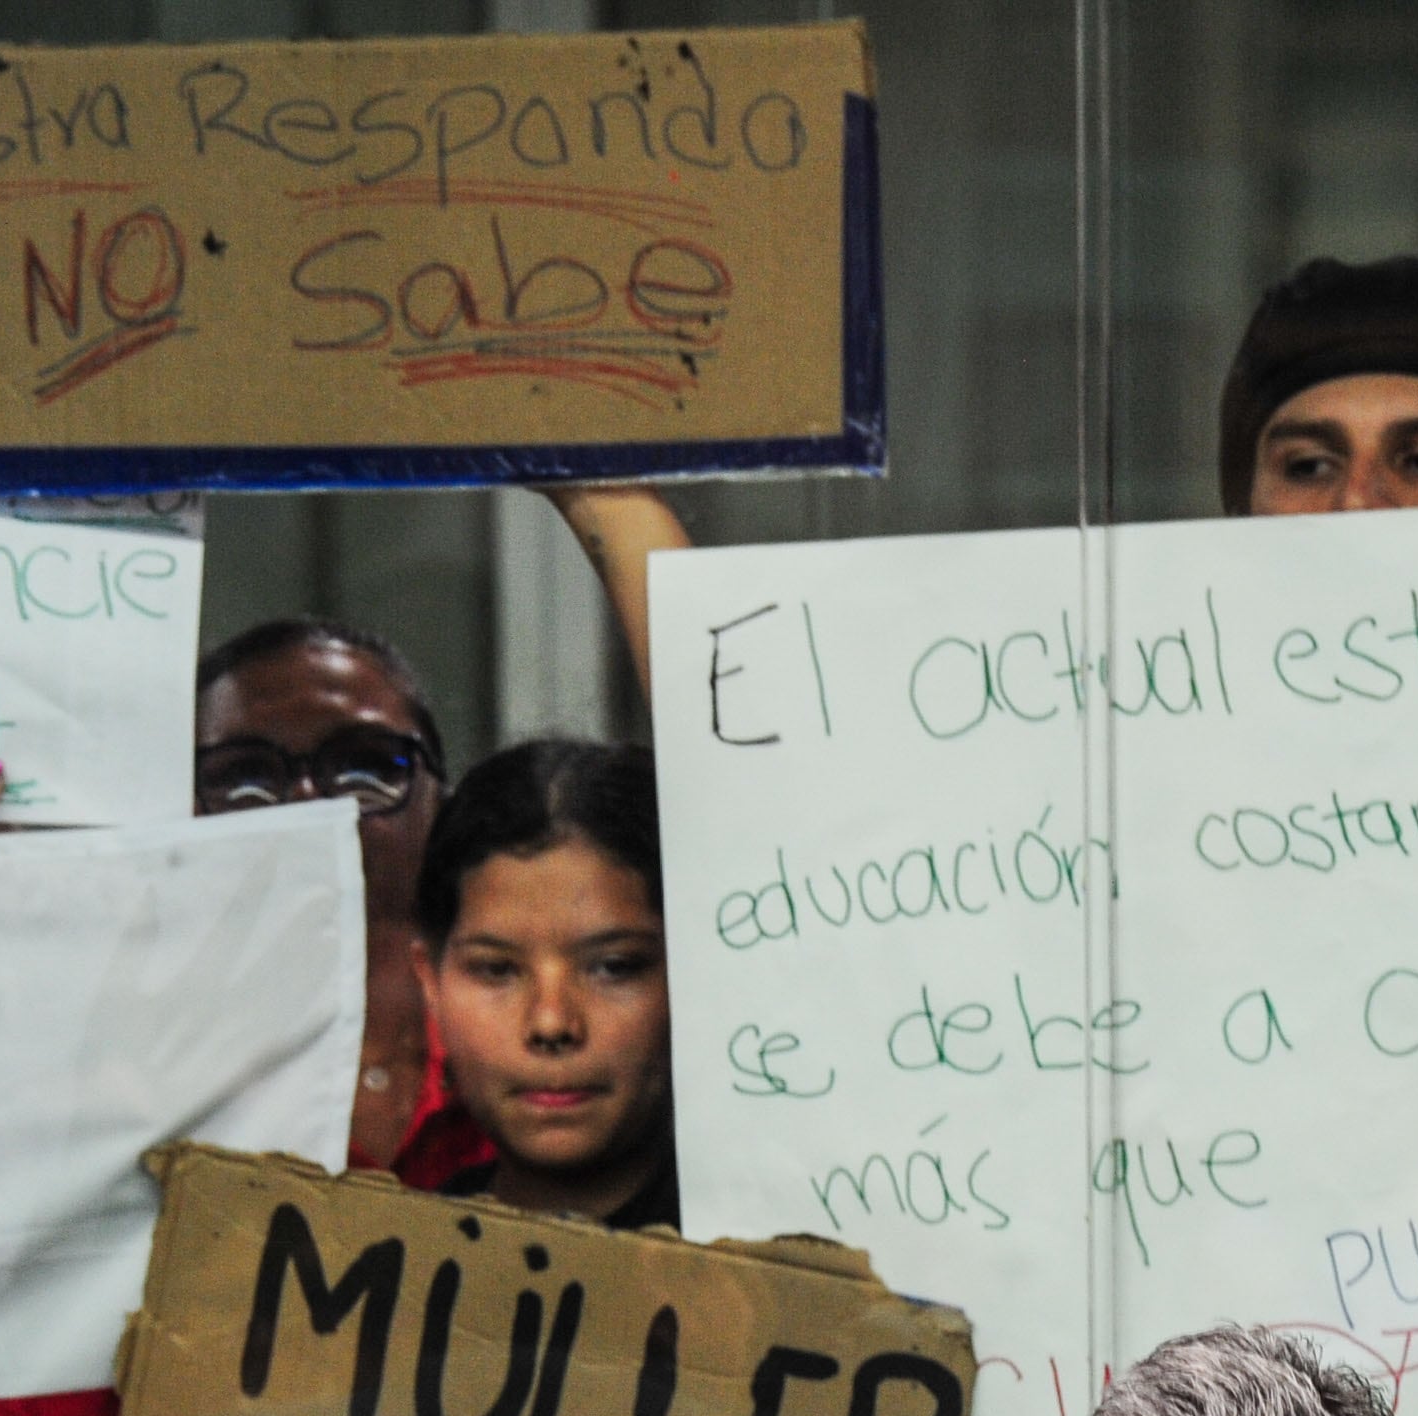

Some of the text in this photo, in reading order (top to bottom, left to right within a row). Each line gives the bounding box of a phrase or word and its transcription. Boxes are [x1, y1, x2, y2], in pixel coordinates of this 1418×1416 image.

[22, 205, 188, 348] NO
[289, 212, 734, 352] Sabe
[709, 600, 831, 747] El
[908, 586, 1232, 741] actual
[715, 803, 1120, 950] educación
[727, 1022, 836, 1099] se
[887, 972, 1151, 1075] debe
[1221, 987, 1294, 1065] a
[810, 1112, 1011, 1232] más
[1091, 1128, 1269, 1268] que
